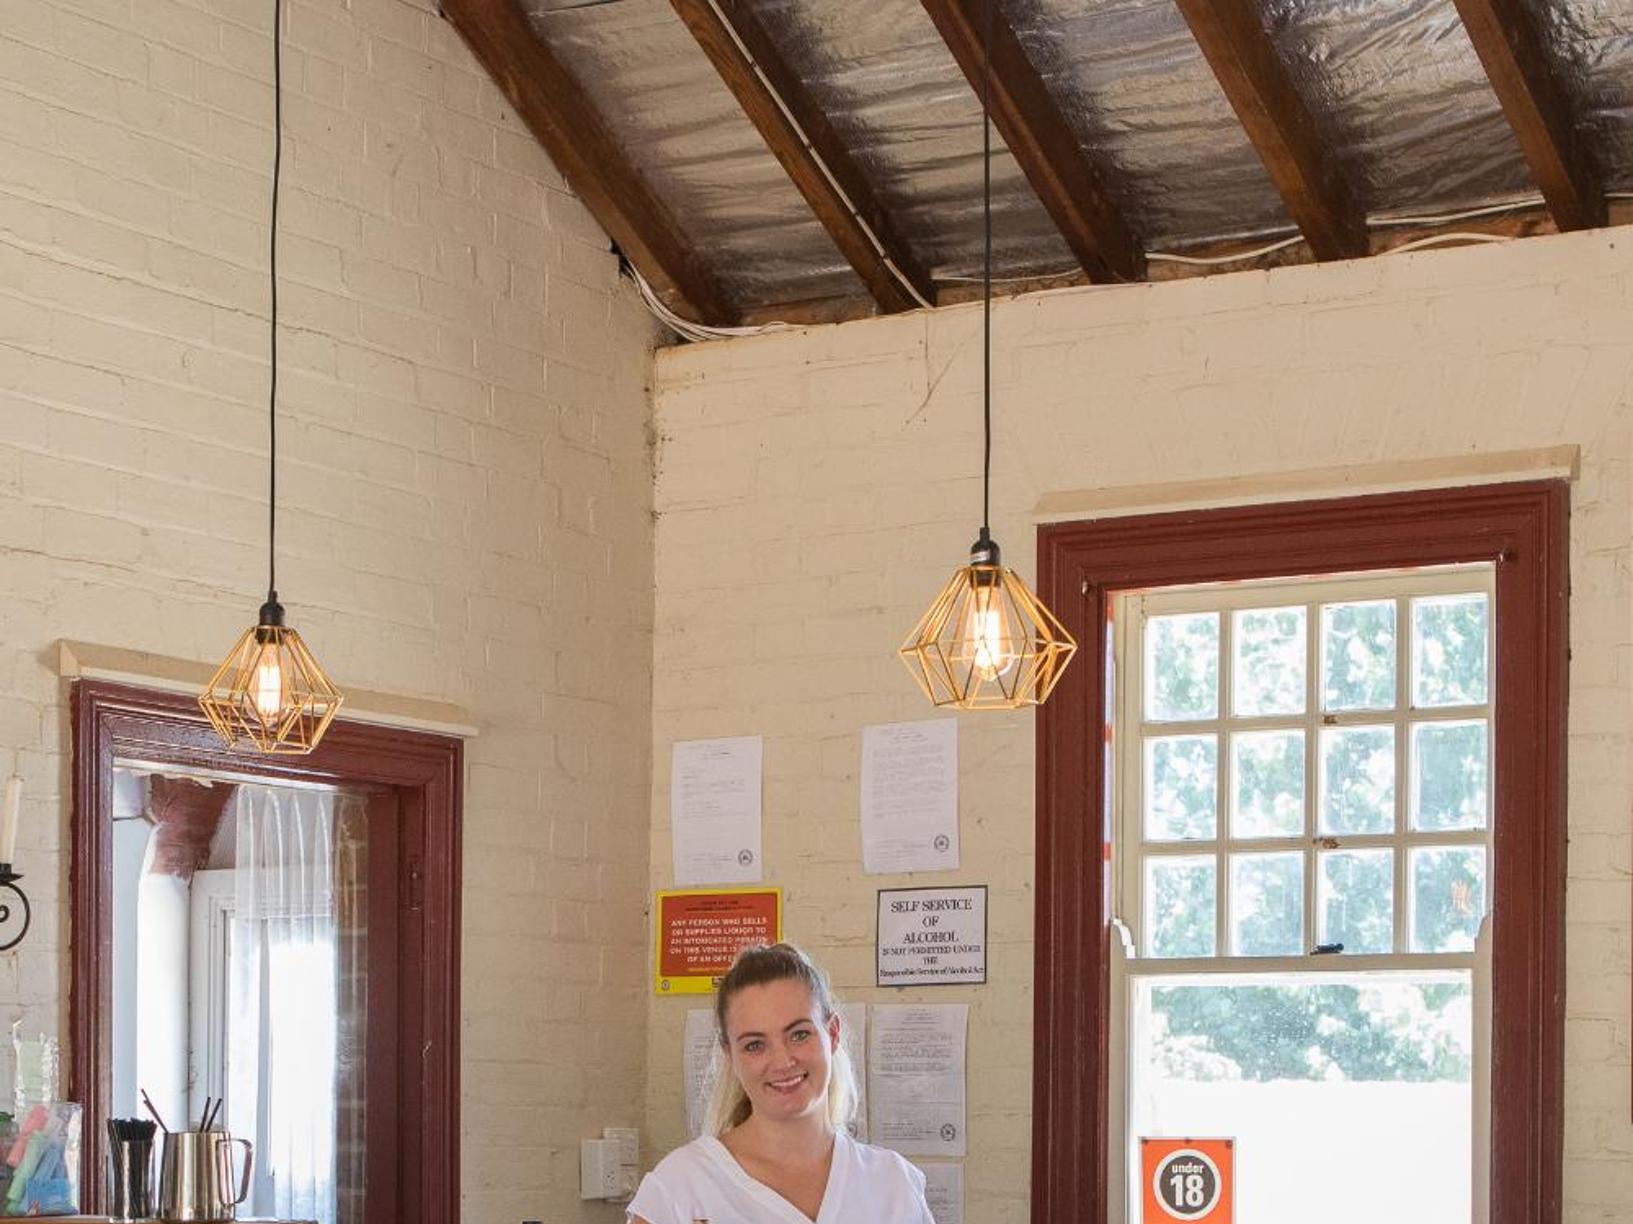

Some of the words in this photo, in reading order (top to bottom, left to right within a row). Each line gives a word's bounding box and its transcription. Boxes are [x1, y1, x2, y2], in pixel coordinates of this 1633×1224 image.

[890, 900, 920, 913] SELF
[922, 898, 973, 911] SERVICE
[688, 918, 720, 926] PERSON
[922, 915, 940, 928] OF
[756, 926, 767, 934] TO
[903, 931, 960, 944] ALCOHOL
[953, 944, 981, 953] UNDER
[1171, 1161, 1204, 1174] under
[1170, 1174, 1204, 1207] 18
